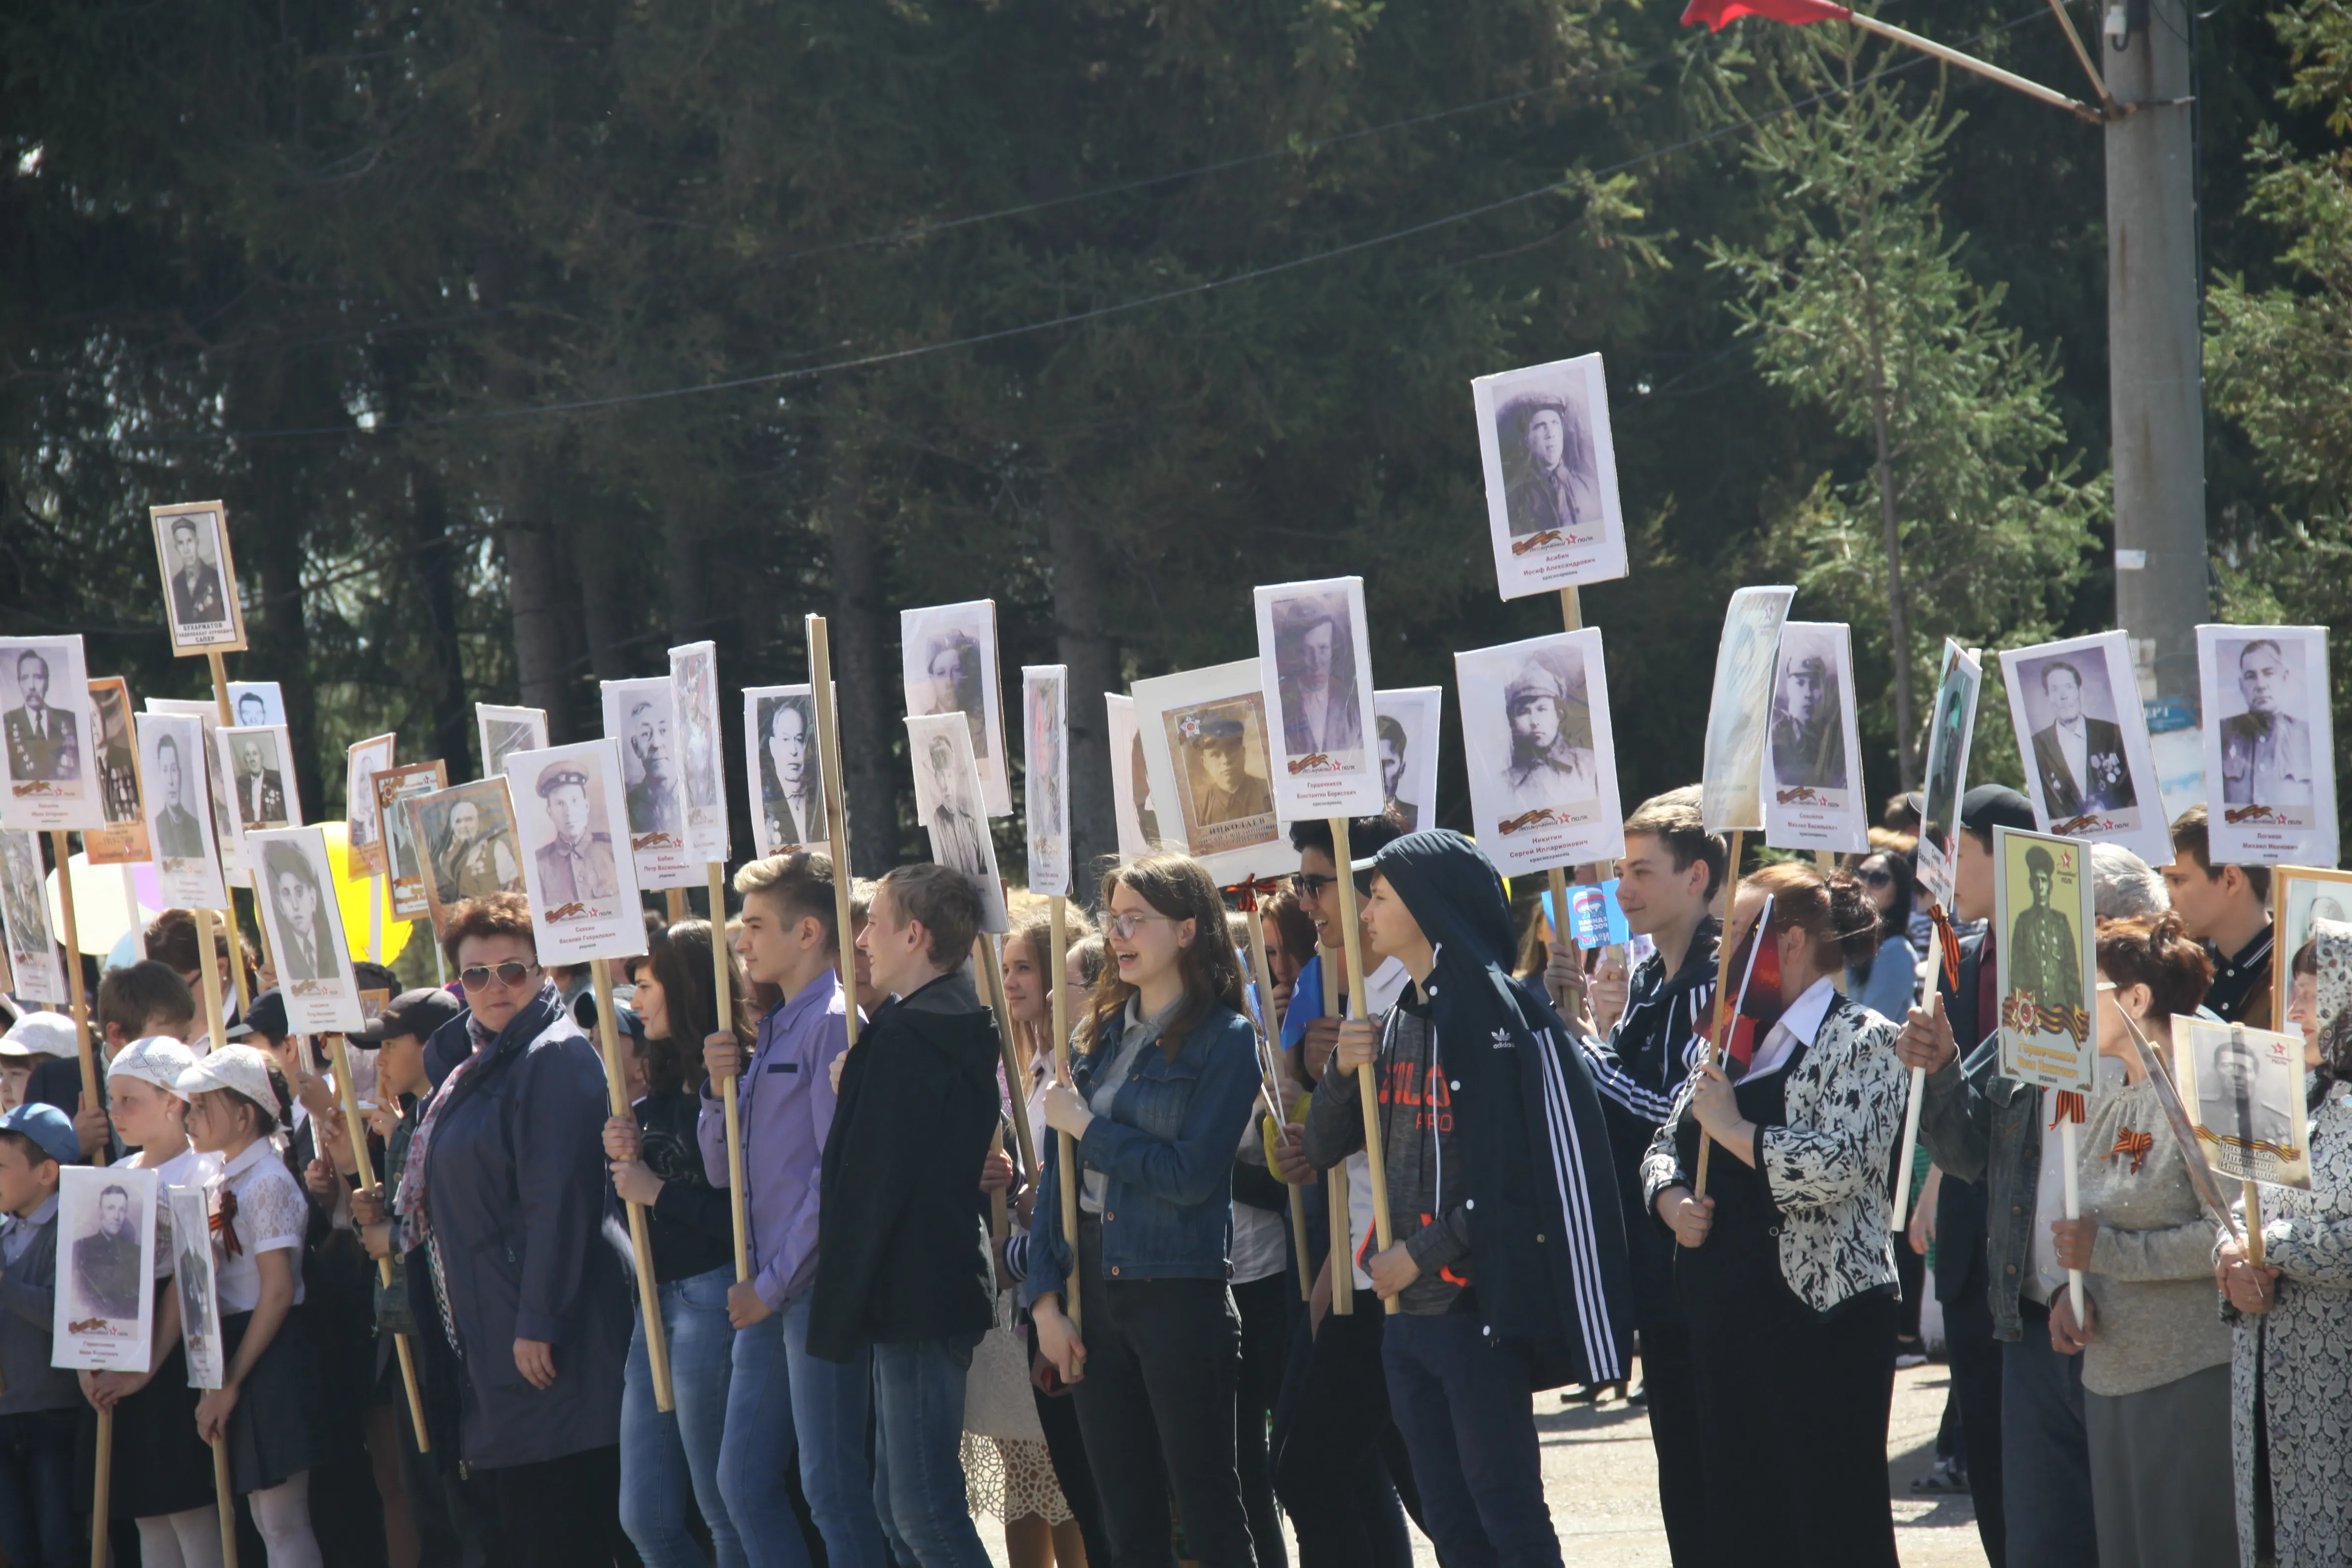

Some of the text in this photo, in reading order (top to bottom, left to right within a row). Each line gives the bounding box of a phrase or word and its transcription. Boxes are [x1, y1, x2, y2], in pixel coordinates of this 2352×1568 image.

[1546, 553, 1569, 562] Асабин
[1523, 558, 1595, 576] Иосиф Александрович
[1542, 571, 1578, 580] красноармеец
[183, 623, 222, 631] БУХАРМАТОВ
[1210, 818, 1265, 834] НИКОЛАЕВ
[1532, 835, 1562, 844] Никитин
[1536, 840, 1588, 853] Илларионович
[1530, 852, 1569, 862] красноармеец
[2039, 1075, 2058, 1083] рядовой
[2219, 1141, 2276, 1160] Васильев
[2222, 1152, 2275, 1171] Никанор
[2220, 1161, 2279, 1181] Иванович
